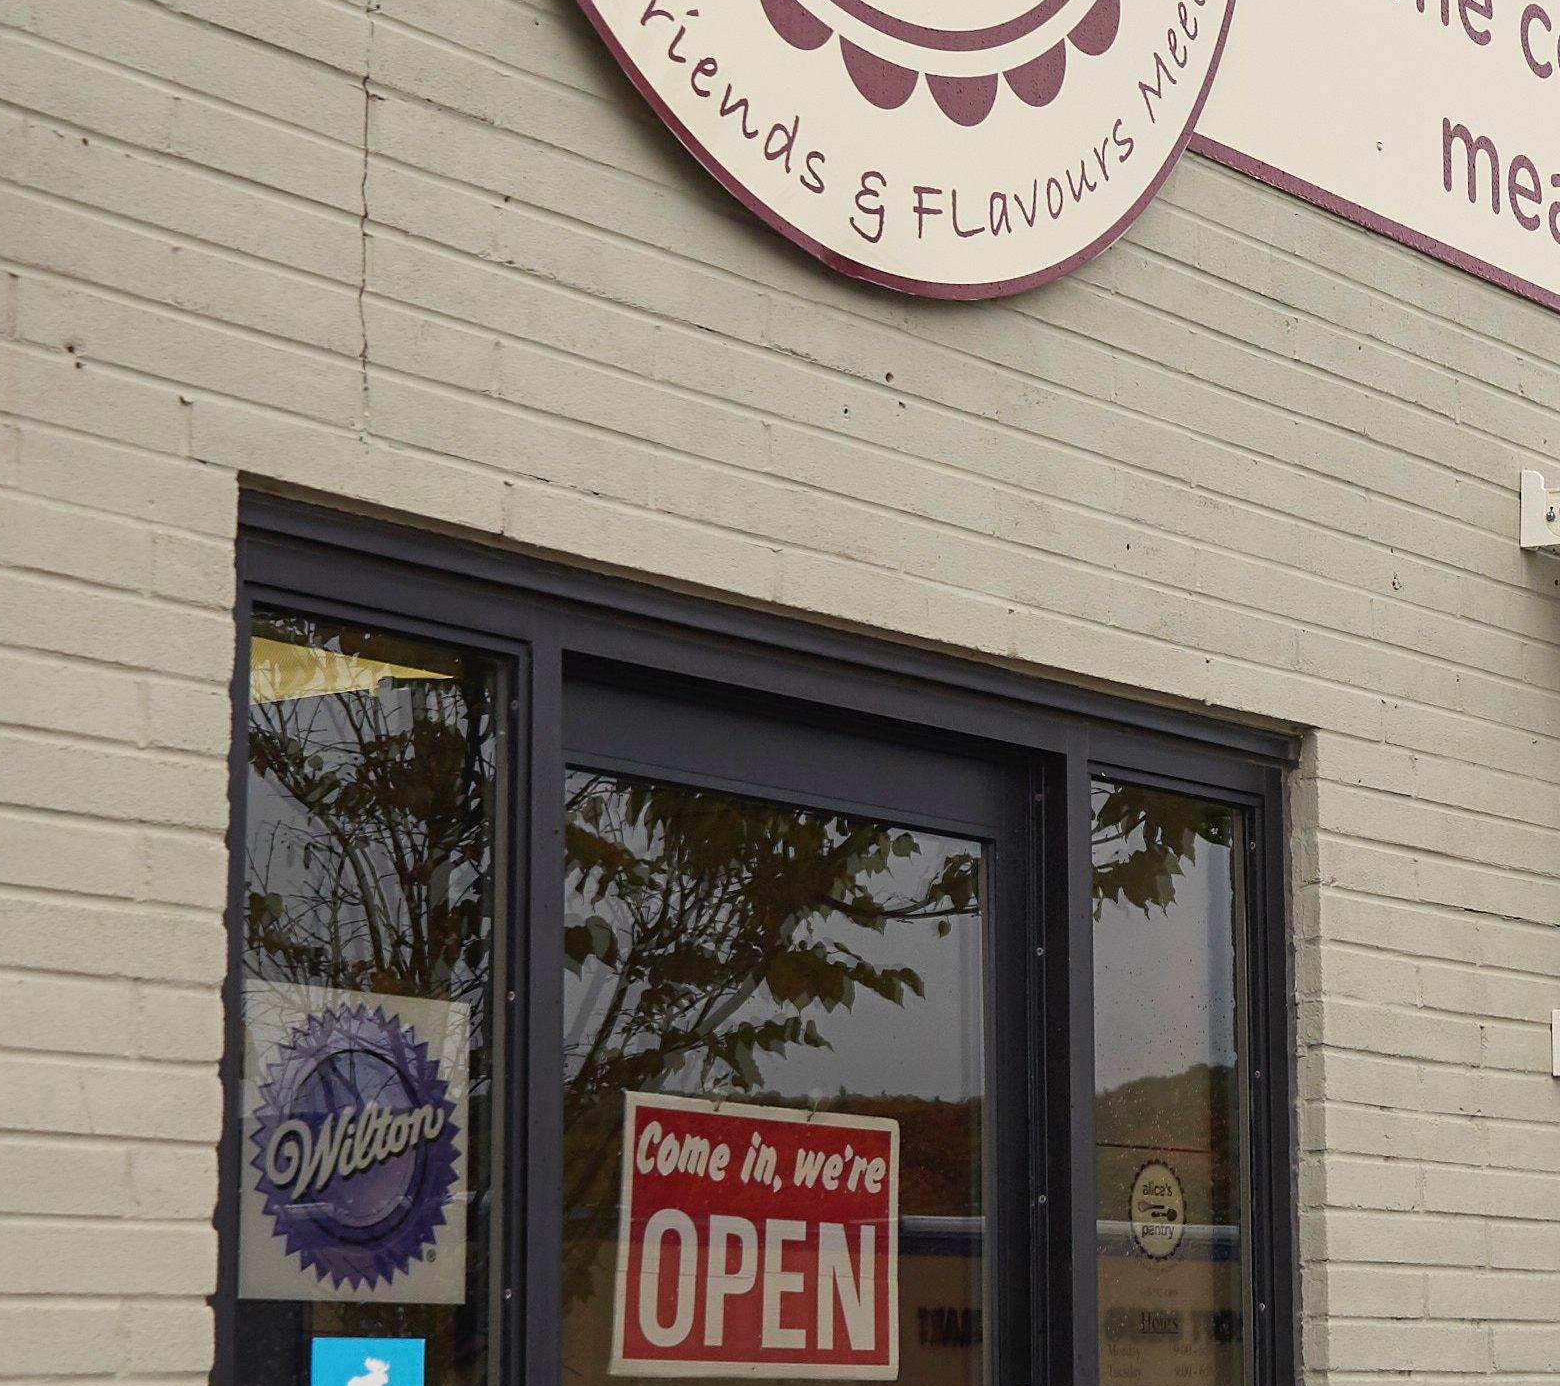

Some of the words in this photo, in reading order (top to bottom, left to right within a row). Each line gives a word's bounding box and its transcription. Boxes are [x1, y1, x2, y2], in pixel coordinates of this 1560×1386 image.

[265, 1099, 444, 1201] Wilton
[635, 1120, 731, 1182] Come
[740, 1131, 783, 1194] in,
[793, 1143, 888, 1194] we're
[1143, 1180, 1174, 1198] alice's
[1142, 1224, 1176, 1240] pantry
[638, 1207, 877, 1351] OPEN
